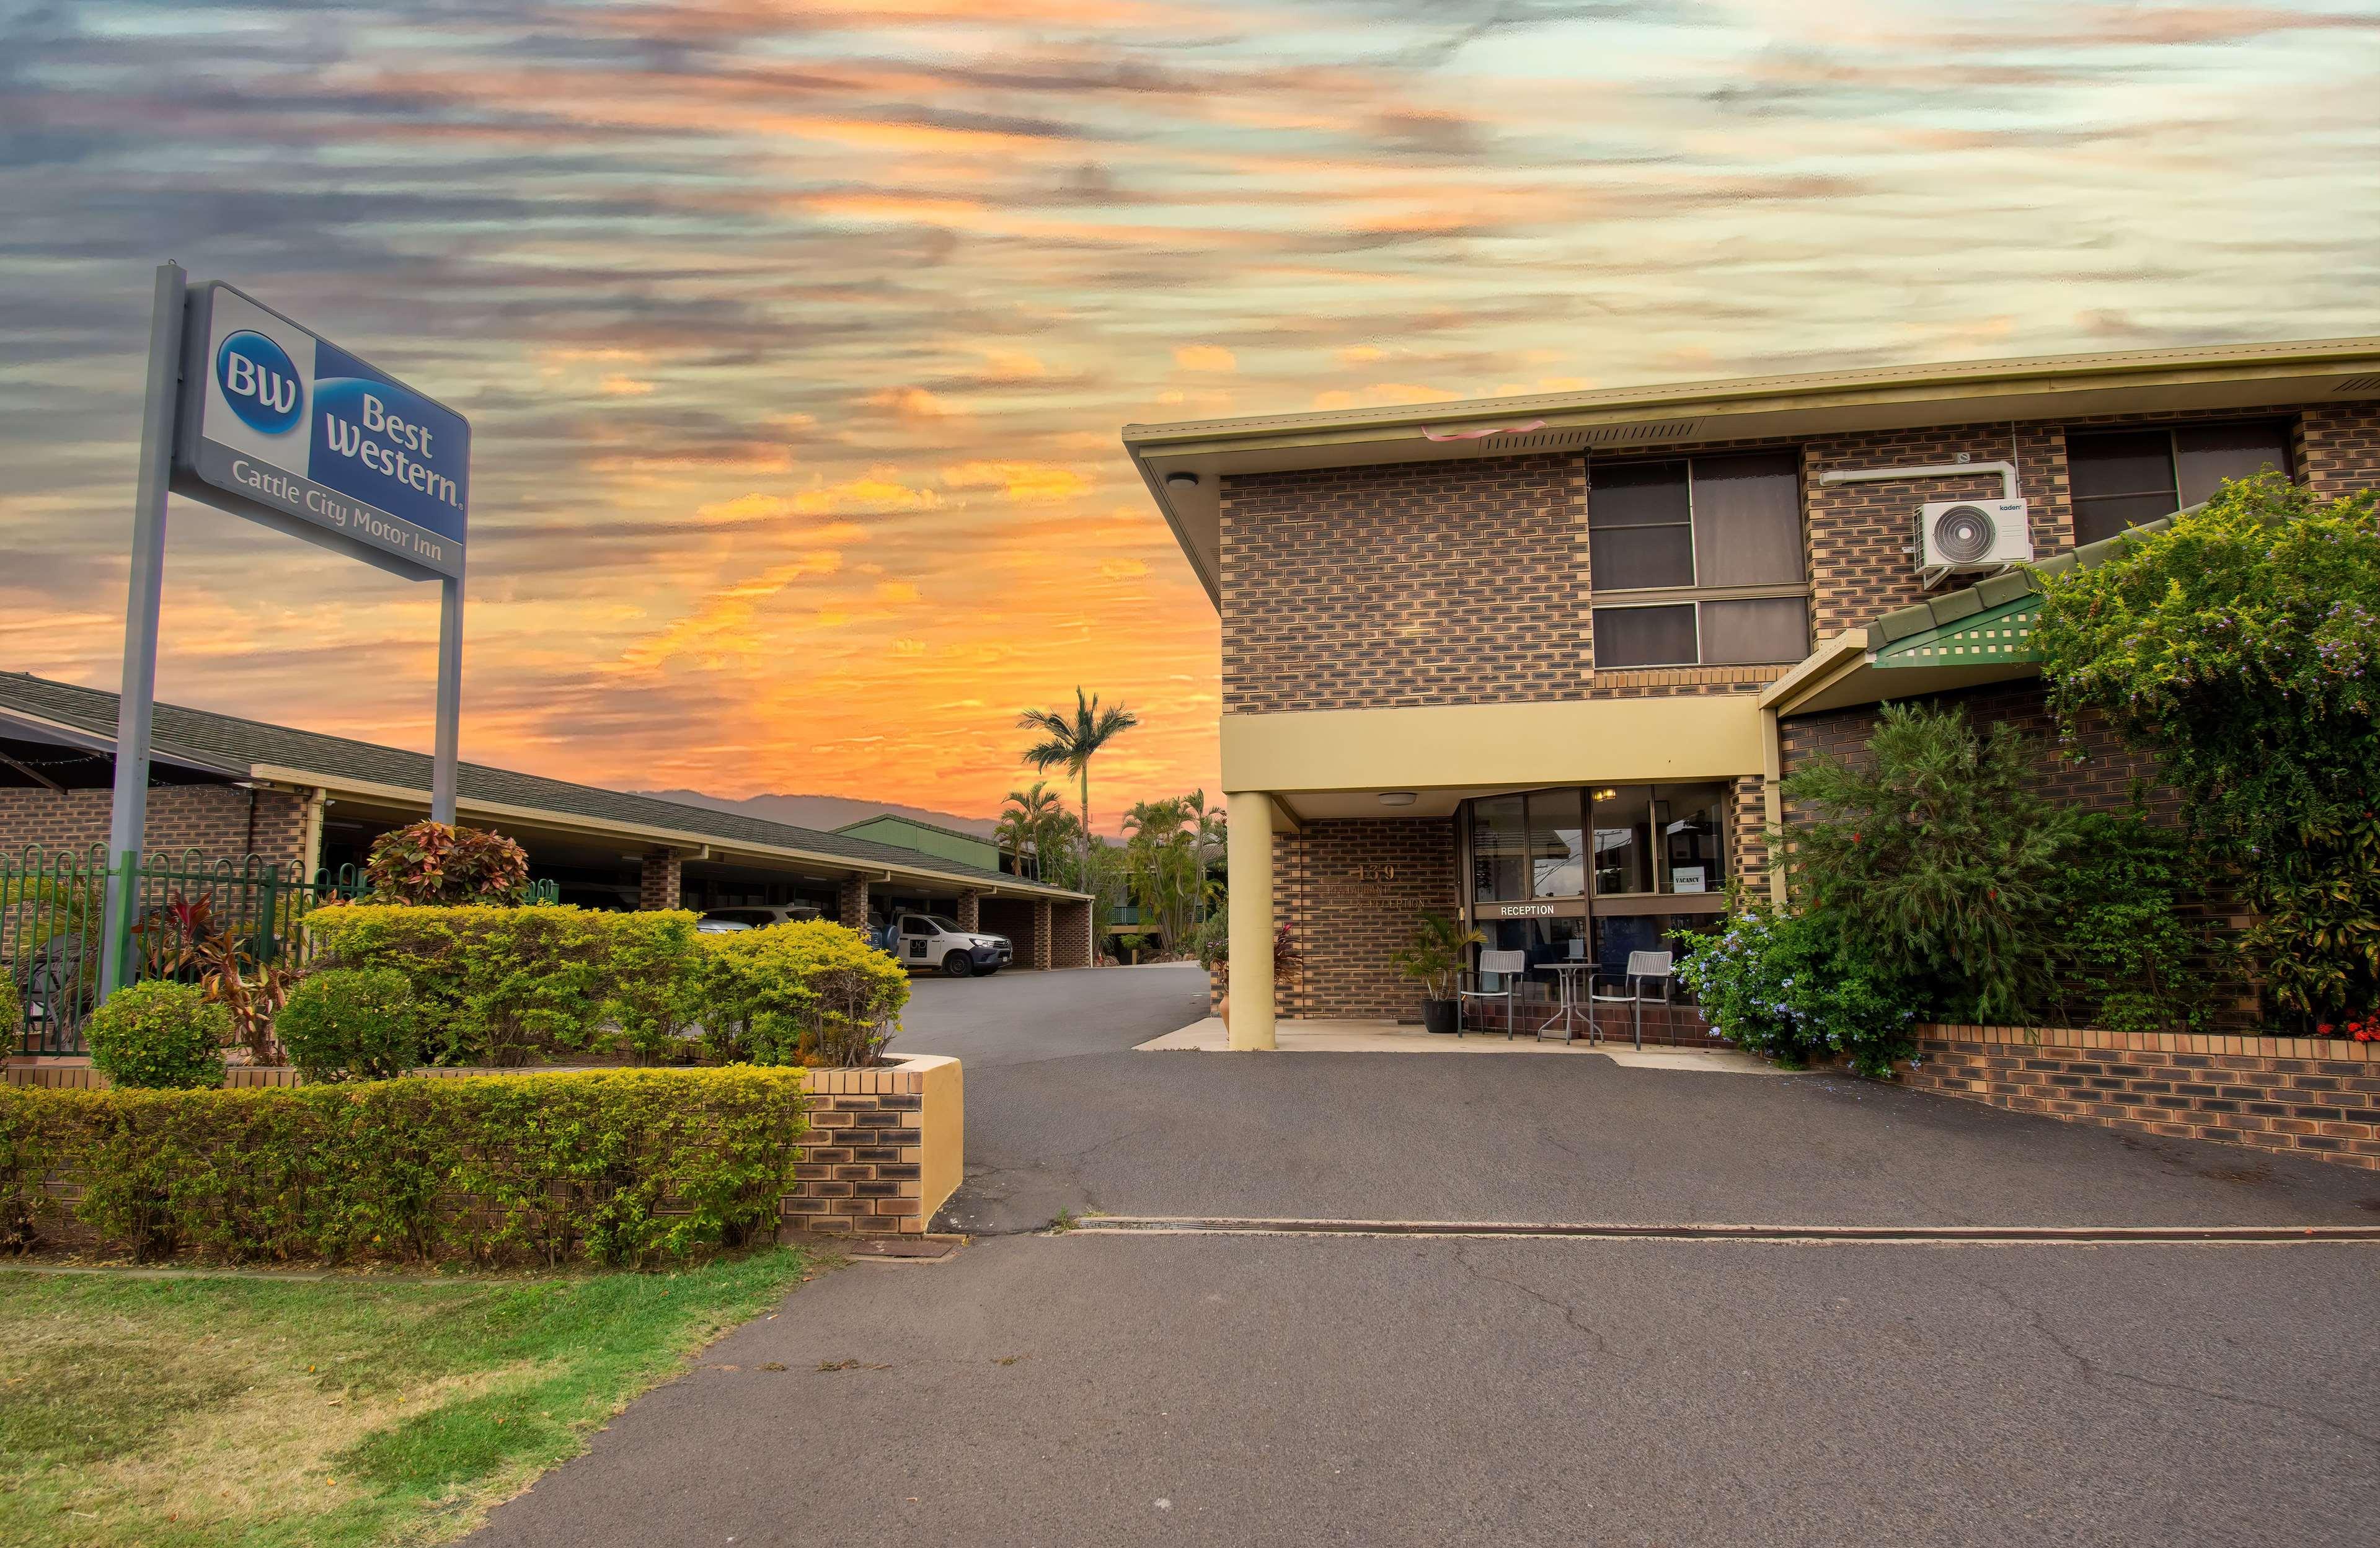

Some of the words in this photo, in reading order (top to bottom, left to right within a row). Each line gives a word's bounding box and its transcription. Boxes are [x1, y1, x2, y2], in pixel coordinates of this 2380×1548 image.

[228, 351, 296, 414] BW
[363, 393, 433, 459] Best
[326, 412, 458, 507] Western
[232, 460, 300, 504] Cattle
[306, 490, 347, 526] City
[353, 508, 410, 546] Motor
[414, 533, 441, 561] Inn
[1359, 864, 1394, 880] 139
[1501, 905, 1554, 916] RECEPTION
